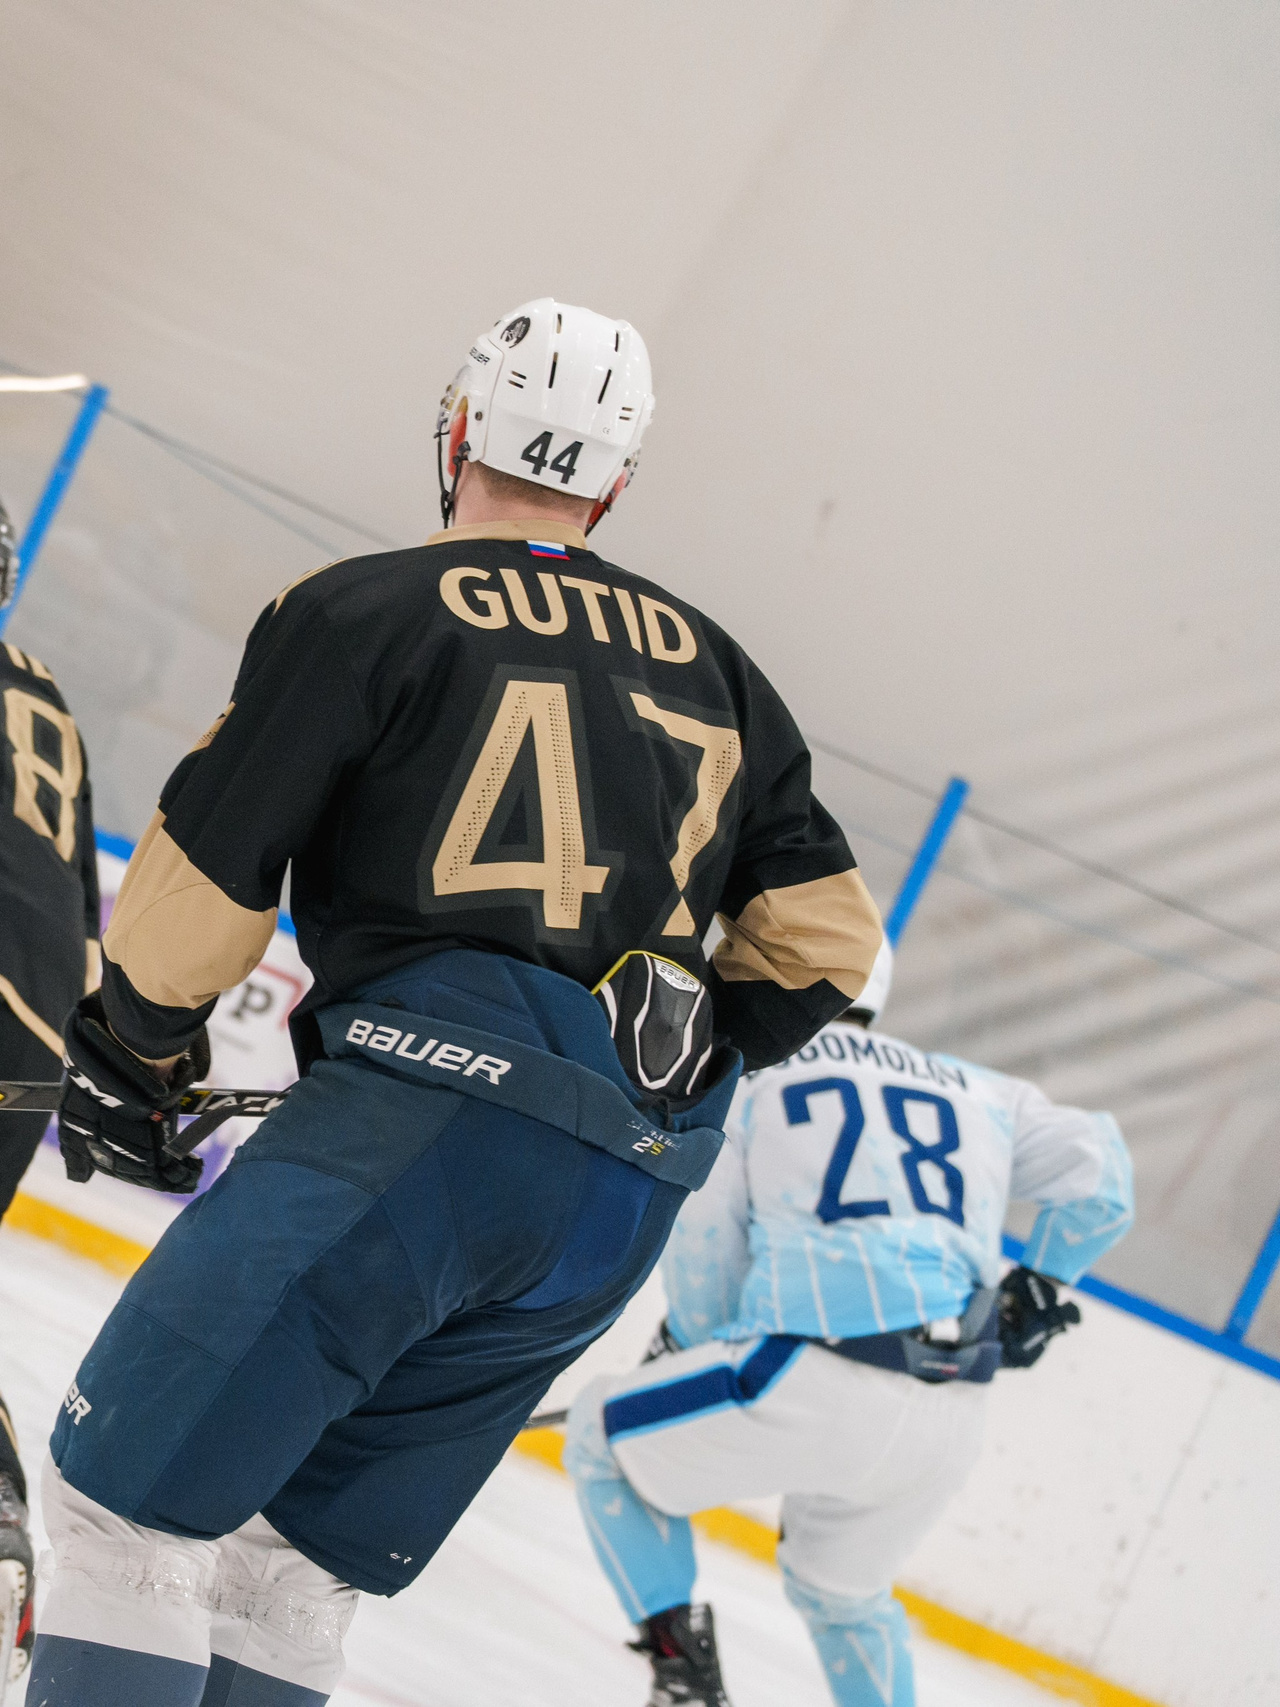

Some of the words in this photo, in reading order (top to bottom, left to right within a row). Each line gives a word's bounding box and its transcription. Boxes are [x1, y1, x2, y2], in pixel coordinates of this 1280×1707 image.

[520, 431, 585, 485] 44
[439, 567, 698, 664] GUTID
[432, 680, 742, 938] 47
[660, 964, 696, 989] BAUER
[346, 1019, 512, 1086] BAUER
[781, 1077, 965, 1228] 28
